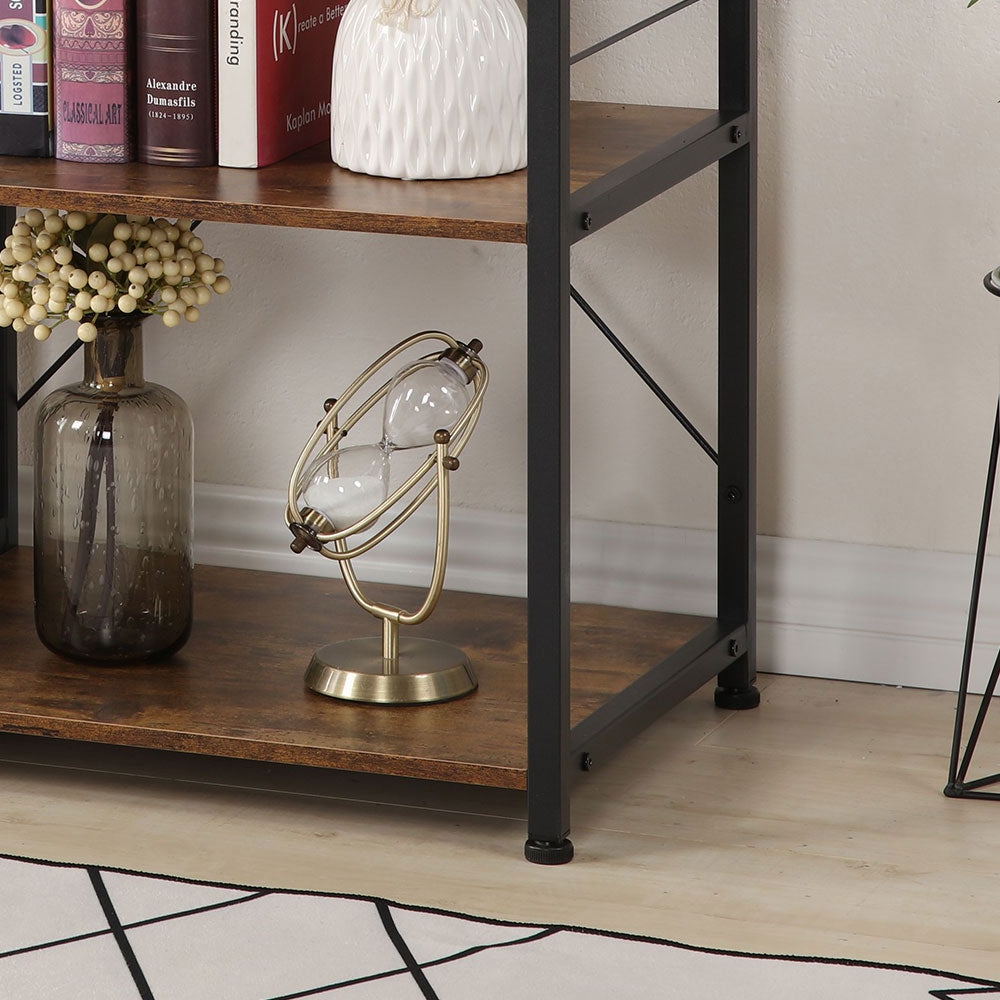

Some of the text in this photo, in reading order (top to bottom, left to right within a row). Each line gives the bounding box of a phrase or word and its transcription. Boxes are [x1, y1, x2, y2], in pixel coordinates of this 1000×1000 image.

[12, 62, 23, 106] LOGSTED
[146, 78, 197, 92] Alexandre
[63, 100, 122, 125] CLASSICAL ART
[147, 94, 196, 107] Dumasfils
[286, 106, 316, 132] Kaplan
